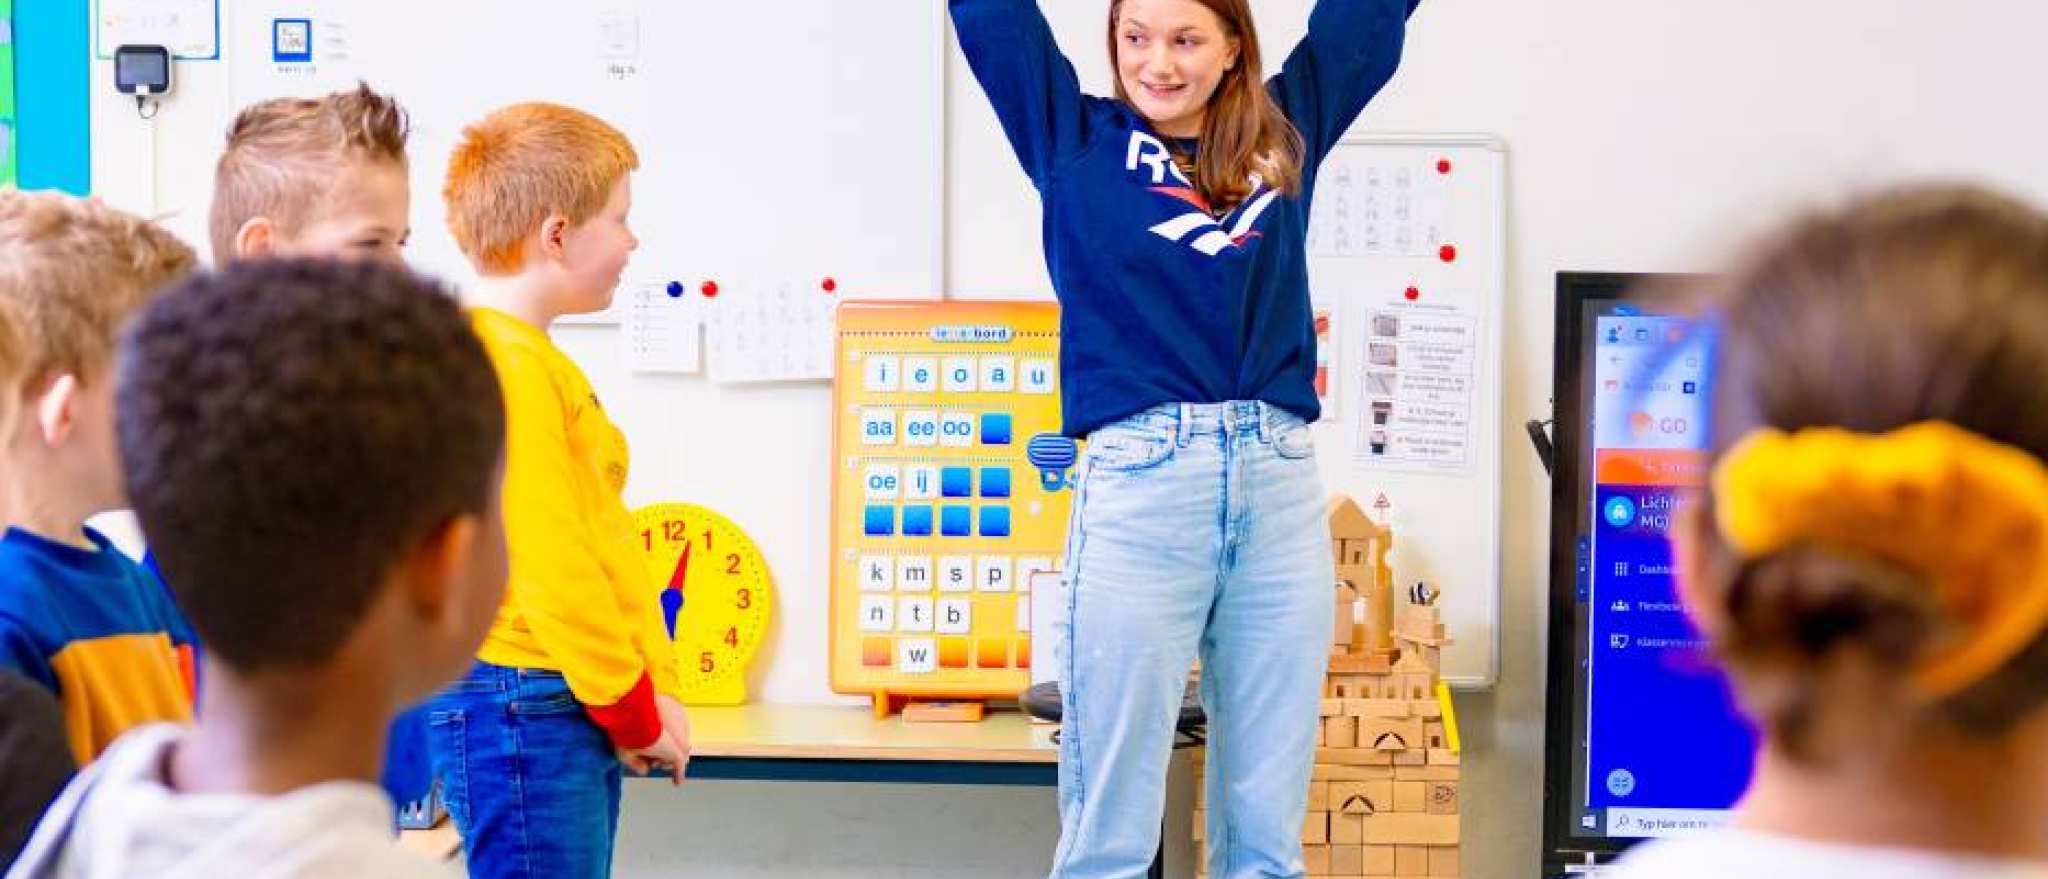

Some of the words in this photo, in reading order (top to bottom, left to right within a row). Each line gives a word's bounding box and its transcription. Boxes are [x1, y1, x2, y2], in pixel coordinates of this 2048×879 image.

[879, 364, 887, 382] i
[914, 367, 929, 383] e
[954, 367, 968, 383] o
[991, 366, 1006, 383] a
[1031, 368, 1045, 384] u
[866, 420, 893, 436] aa
[908, 420, 936, 436] ee
[943, 420, 971, 435] oo
[868, 474, 897, 490] oe
[916, 470, 928, 493] ij
[661, 520, 686, 541] 12
[702, 530, 713, 551] 1
[726, 553, 741, 574] 2
[871, 563, 884, 581] k
[905, 566, 925, 582] m
[950, 566, 963, 582] s
[989, 566, 1002, 586] p
[736, 588, 751, 610] 3
[870, 606, 884, 621] n
[911, 604, 921, 622] t
[947, 605, 960, 624] b
[724, 627, 739, 648] 4
[700, 651, 715, 673] 5
[908, 648, 928, 662] w
